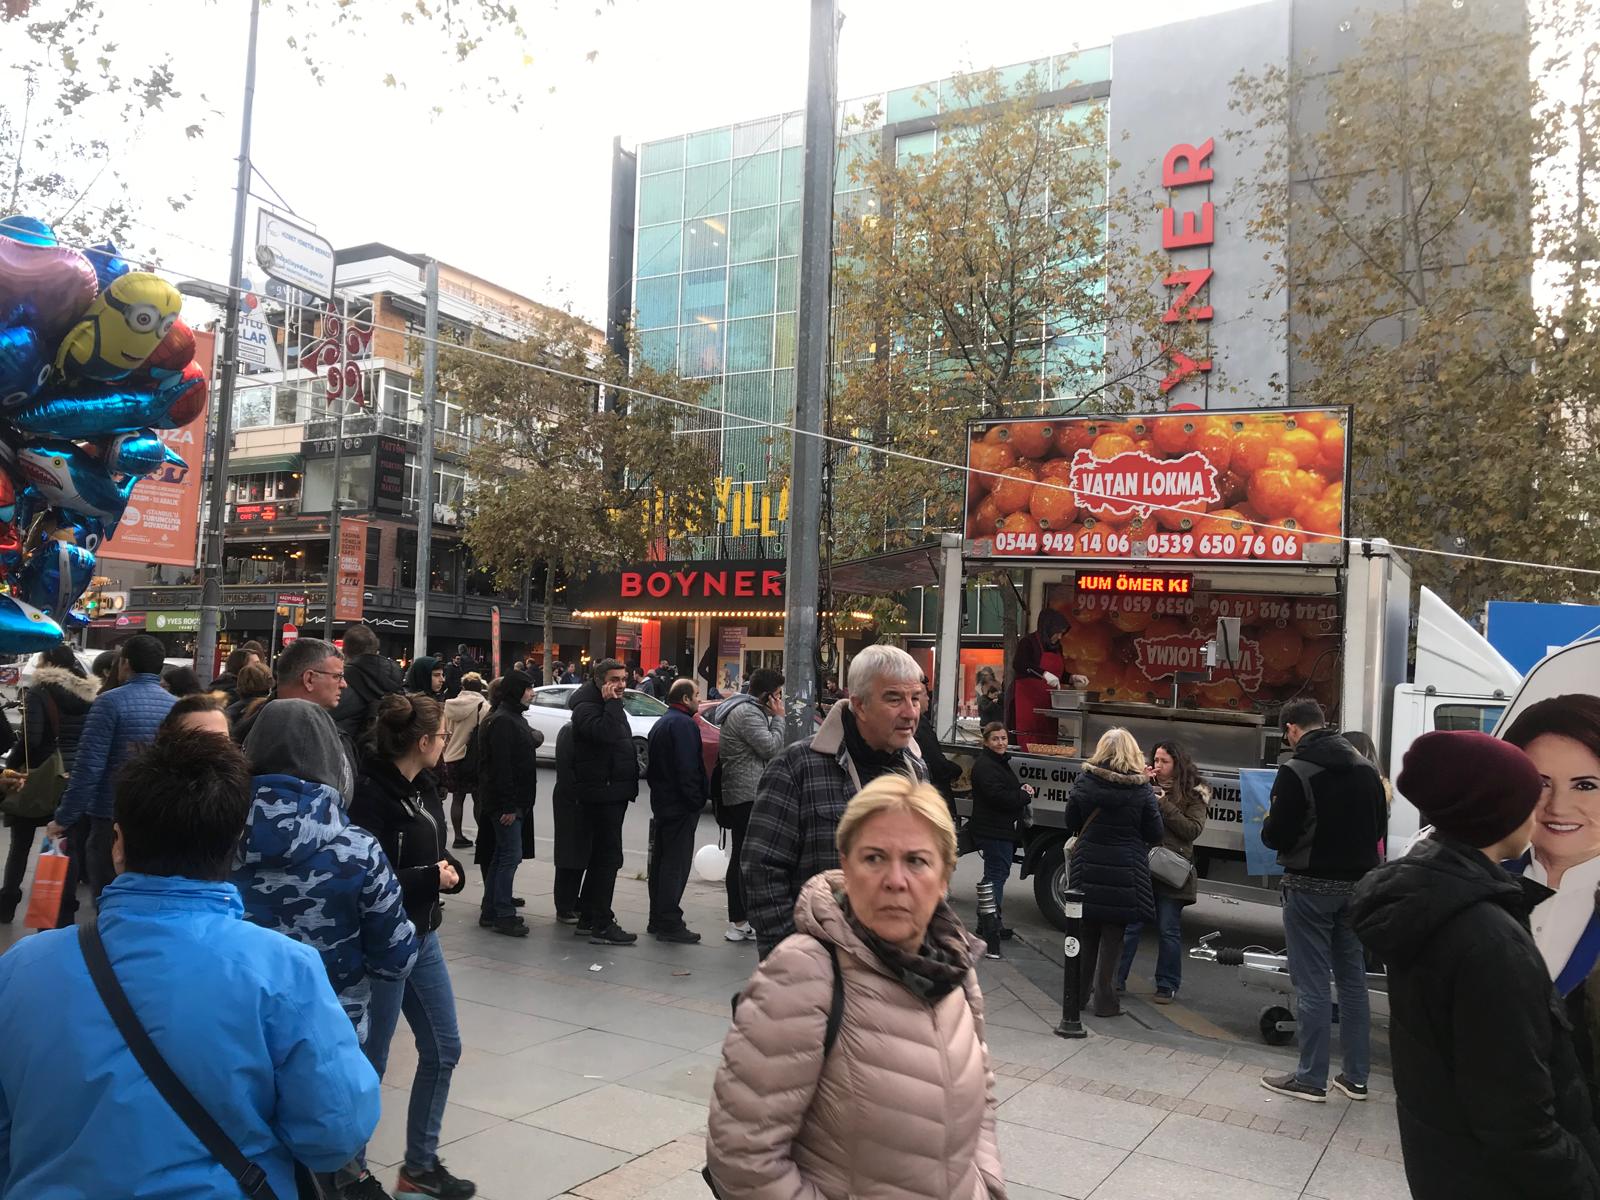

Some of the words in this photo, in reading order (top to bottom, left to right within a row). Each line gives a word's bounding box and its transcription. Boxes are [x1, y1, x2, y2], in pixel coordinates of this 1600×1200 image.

[1161, 137, 1214, 412] YNER
[239, 328, 268, 346] LAR
[154, 428, 194, 444] UZA
[314, 438, 362, 453] TATOO
[1082, 473, 1139, 496] VATAN
[1143, 472, 1205, 496] LOKMA
[995, 533, 1037, 551] 0544
[1042, 534, 1074, 552] 942
[1080, 534, 1101, 552] 14
[1106, 534, 1129, 553] 06
[1147, 534, 1193, 553] 0539
[1199, 535, 1235, 554] 650
[1241, 535, 1266, 554] 76
[1272, 535, 1297, 555] 06
[620, 571, 783, 598] BOYNER
[1116, 574, 1164, 592] ÖMER
[361, 616, 409, 628] MAC
[1018, 762, 1048, 781] ÖZEL
[1051, 767, 1080, 784] GÜN
